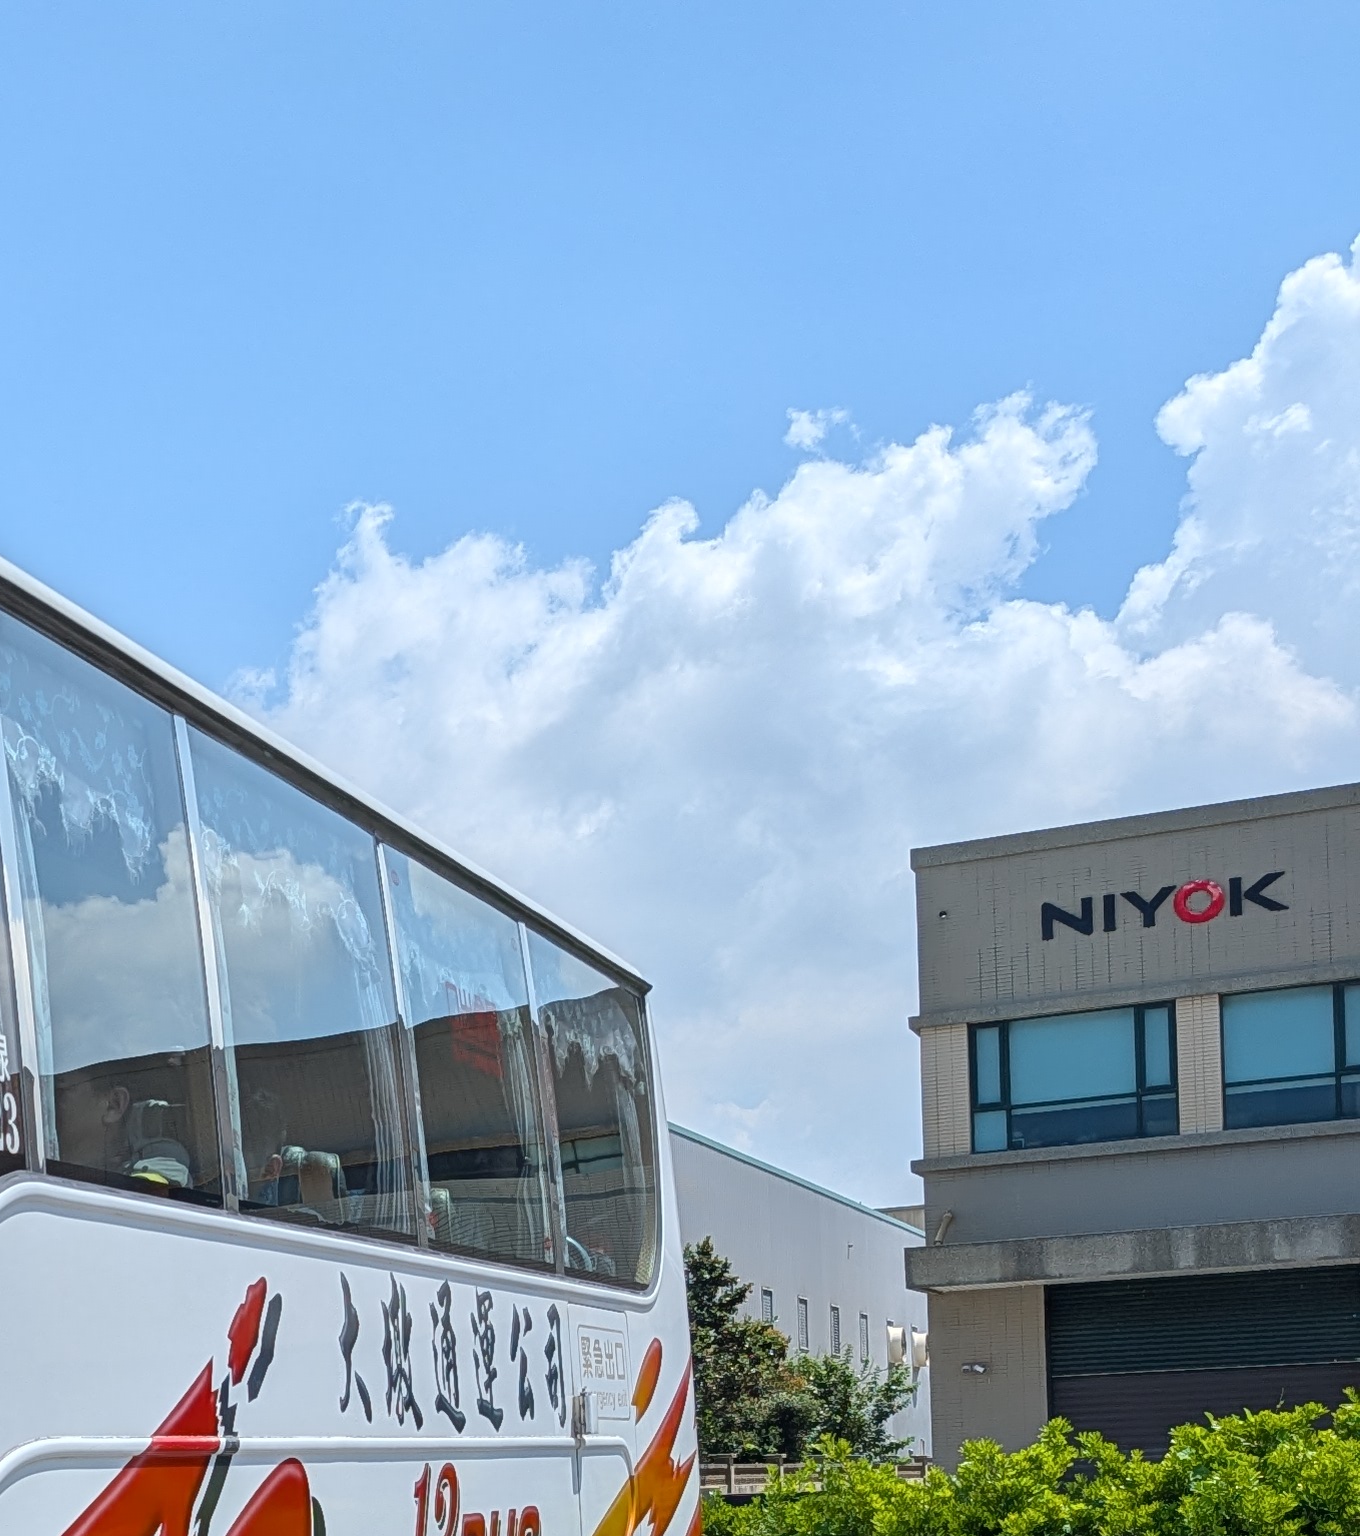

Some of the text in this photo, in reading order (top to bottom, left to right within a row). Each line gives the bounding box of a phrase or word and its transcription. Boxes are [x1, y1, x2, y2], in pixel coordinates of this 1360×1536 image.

[1041, 870, 1290, 941] NIYOK
[580, 1336, 626, 1380] 緊急出口
